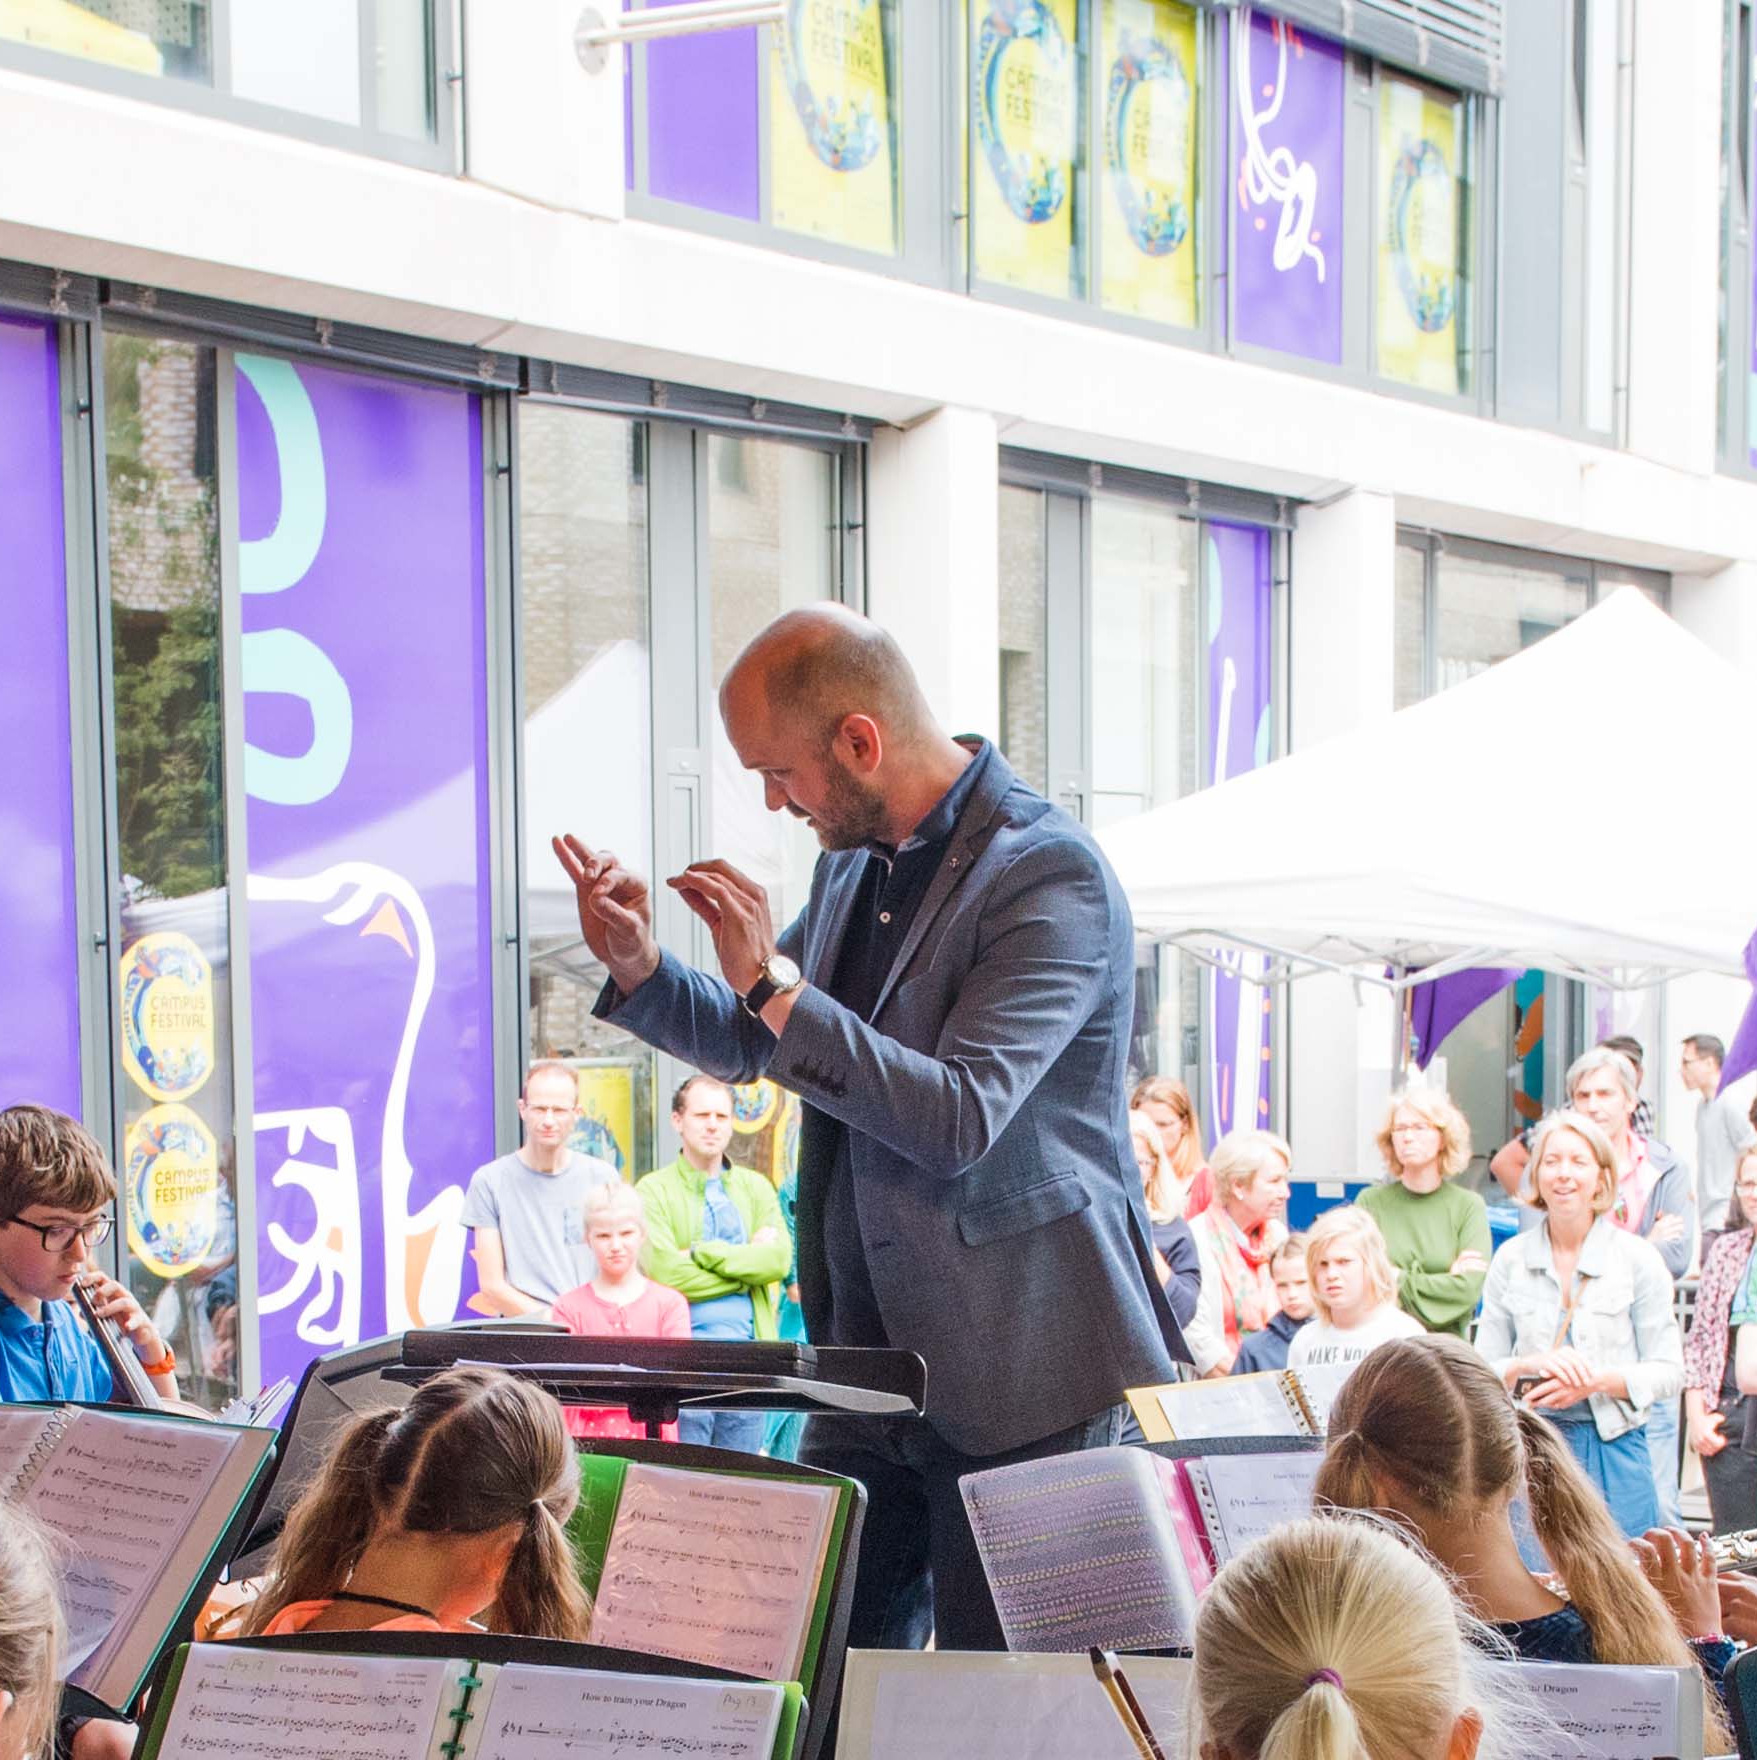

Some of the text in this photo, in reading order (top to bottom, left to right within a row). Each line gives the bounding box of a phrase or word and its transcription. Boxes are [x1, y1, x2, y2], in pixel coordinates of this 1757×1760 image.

[150, 995, 206, 1010] CAMPUS
[150, 1013, 206, 1029] FESTIVAL
[154, 1168, 211, 1186] CAMPUS
[1307, 1345, 1339, 1365] MAKE
[1543, 1684, 1578, 1695] Dragon
[581, 1692, 687, 1710] How to train your Dragon
